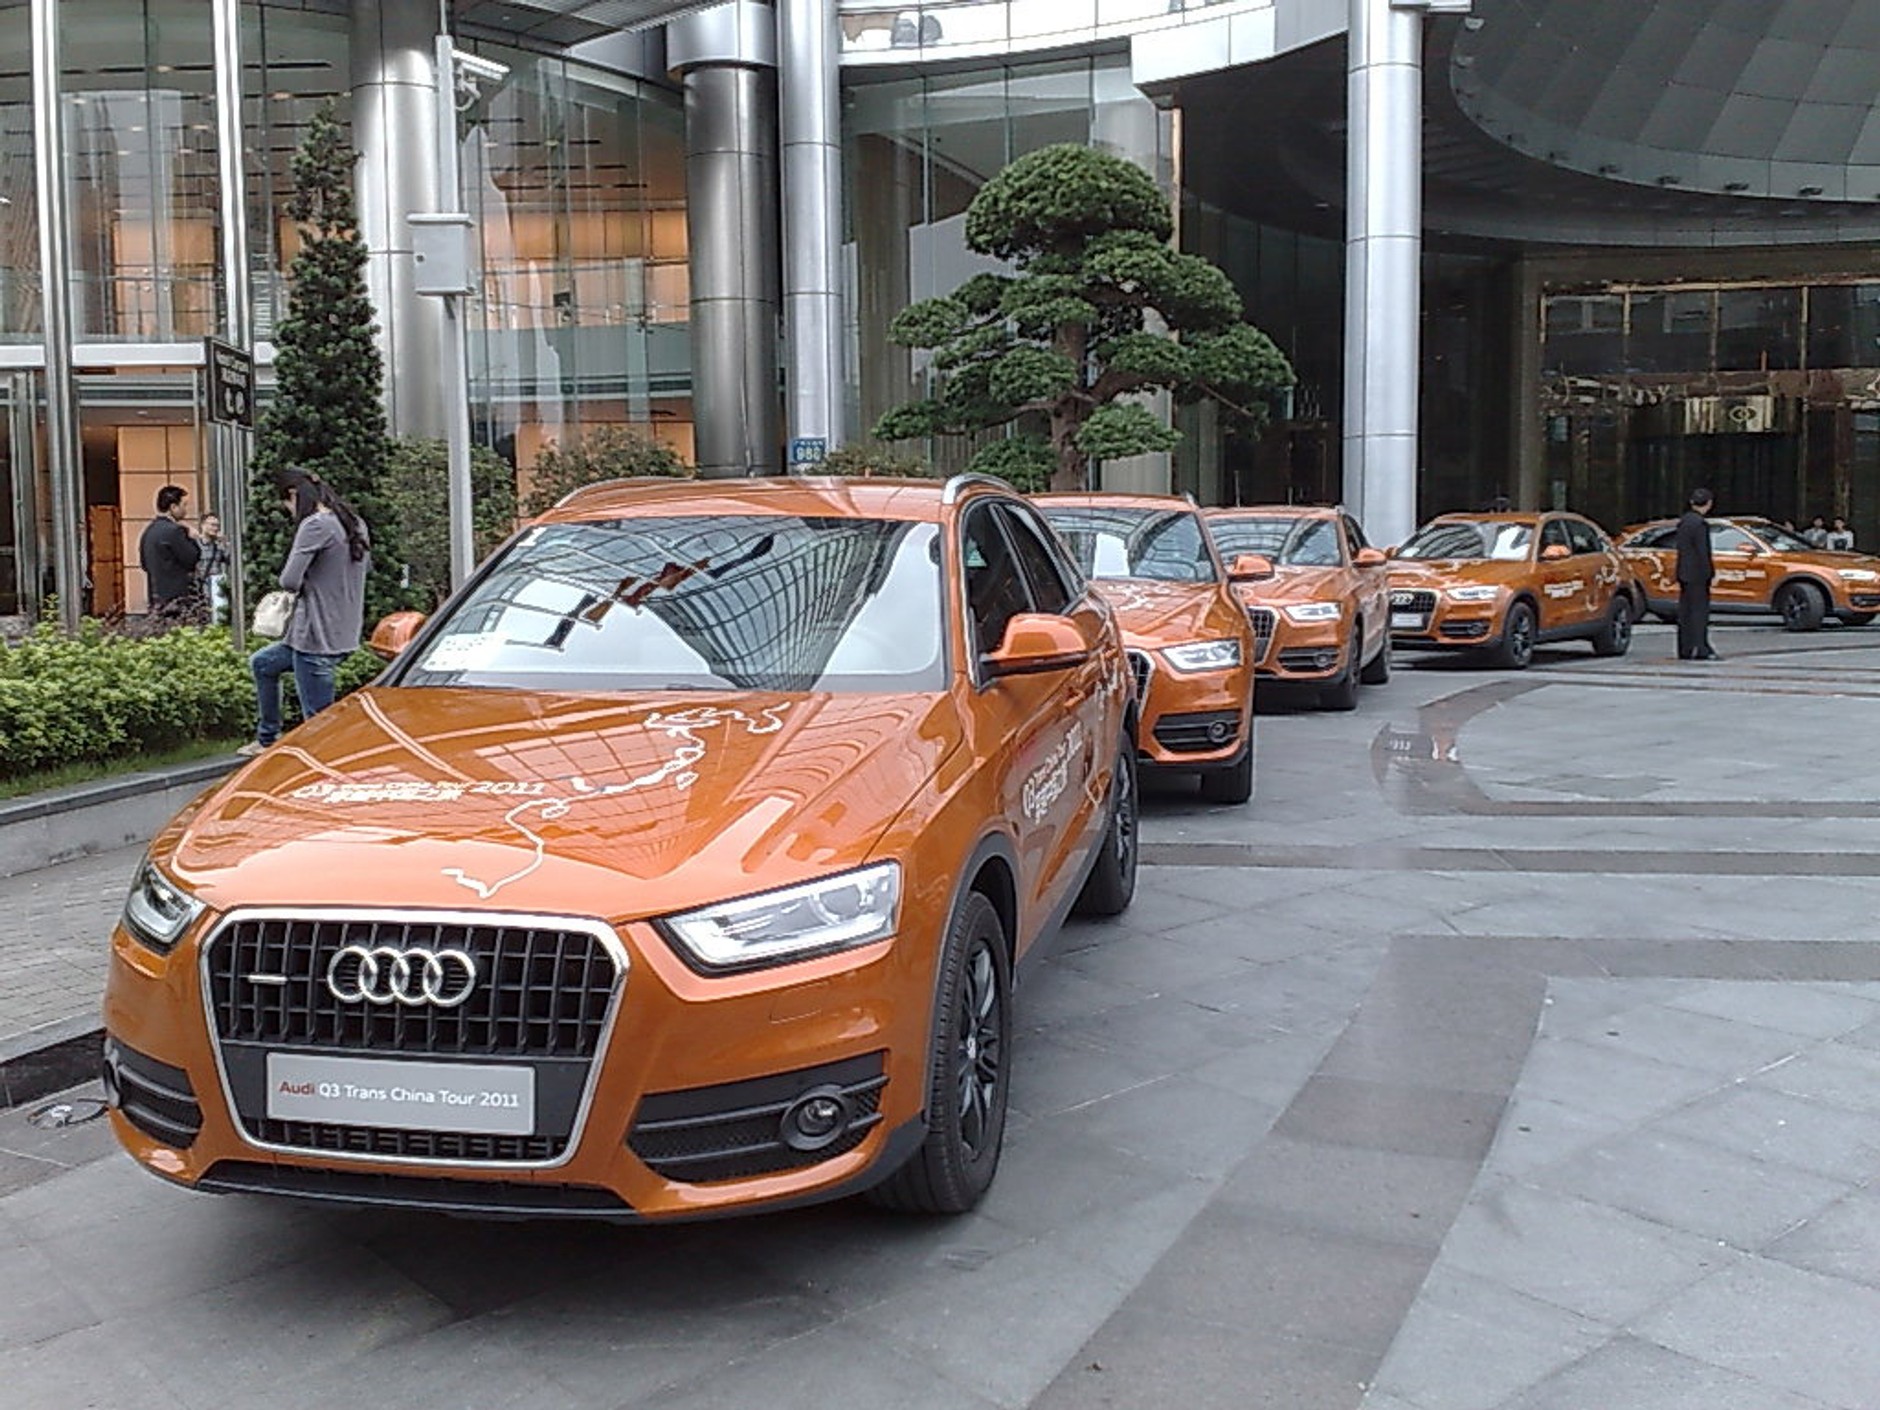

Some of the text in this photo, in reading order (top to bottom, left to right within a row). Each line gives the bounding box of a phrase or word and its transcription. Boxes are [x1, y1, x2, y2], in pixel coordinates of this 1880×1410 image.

[469, 780, 546, 796] 2011
[278, 1081, 519, 1108] Audi Q3 Trans China Tour 2011
